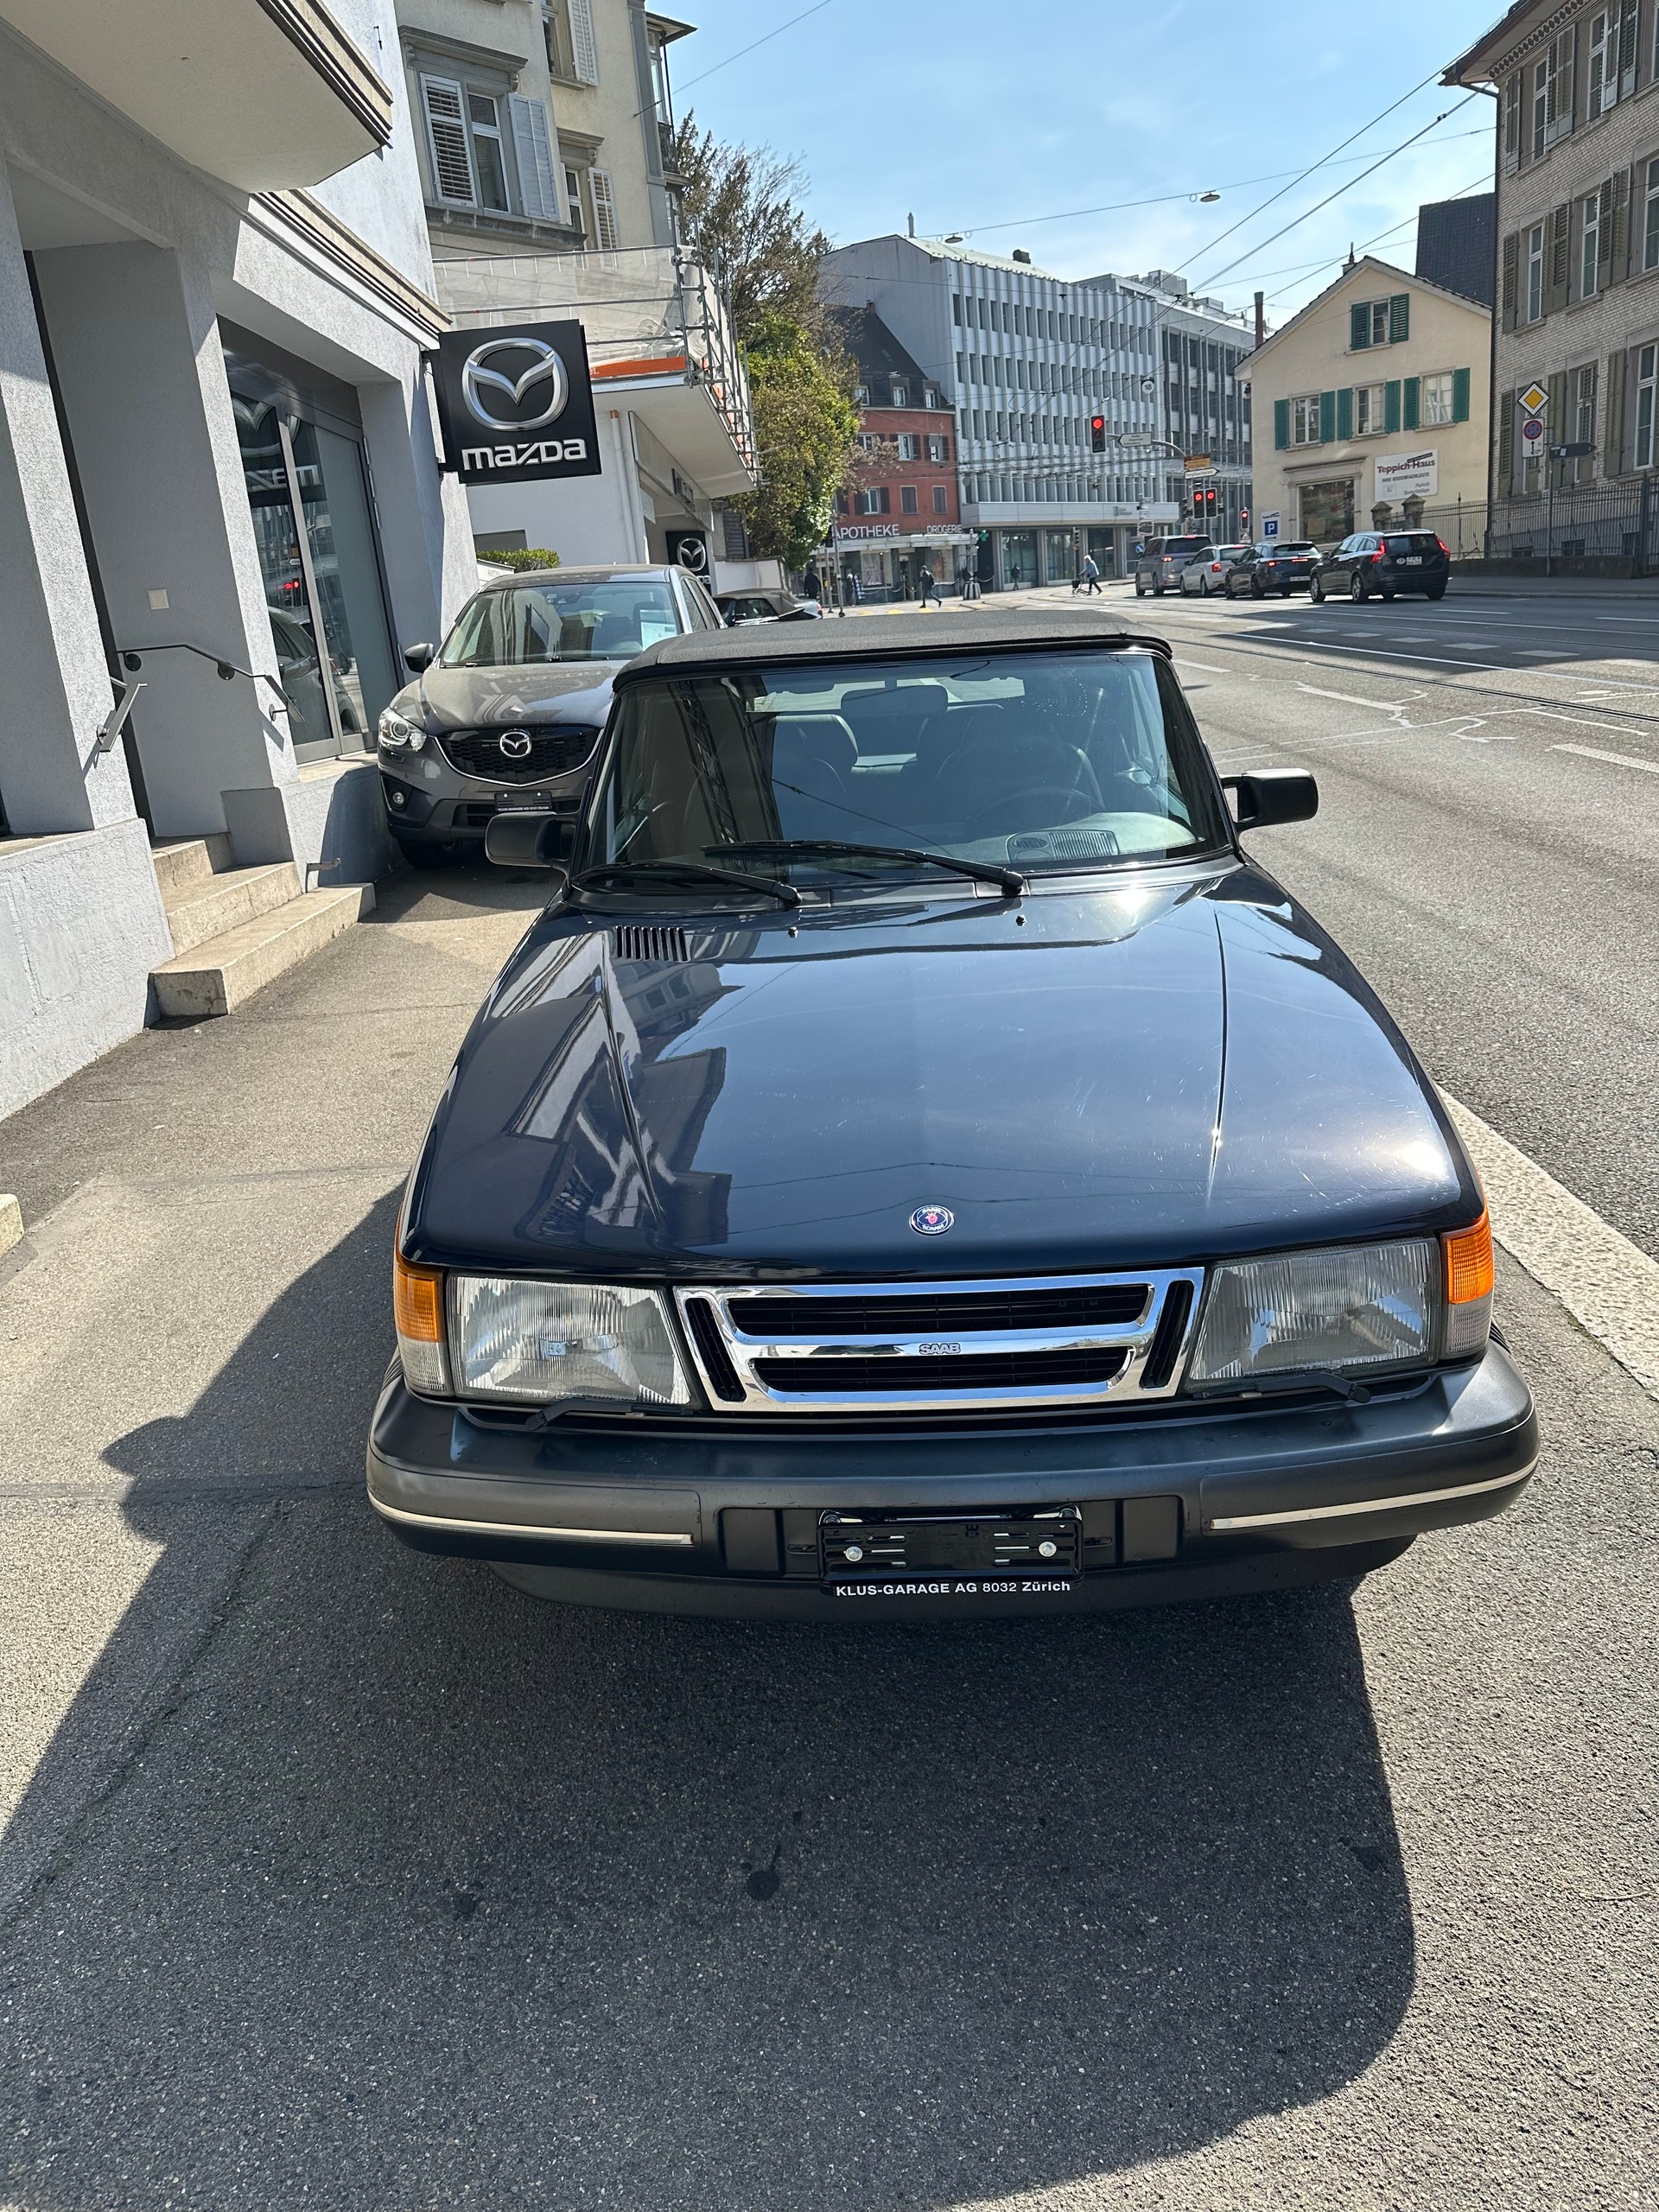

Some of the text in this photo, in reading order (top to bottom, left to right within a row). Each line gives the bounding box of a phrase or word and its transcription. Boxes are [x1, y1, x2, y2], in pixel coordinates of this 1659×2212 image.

[461, 438, 588, 471] mazda
[1376, 460, 1435, 474] Teppich-Haus
[926, 524, 963, 535] DROGERIE
[1268, 523, 1275, 534] P
[918, 1342, 961, 1355] SAAB
[836, 1580, 1071, 1597] KLUS-GARAGE AG 8032 Zürich
